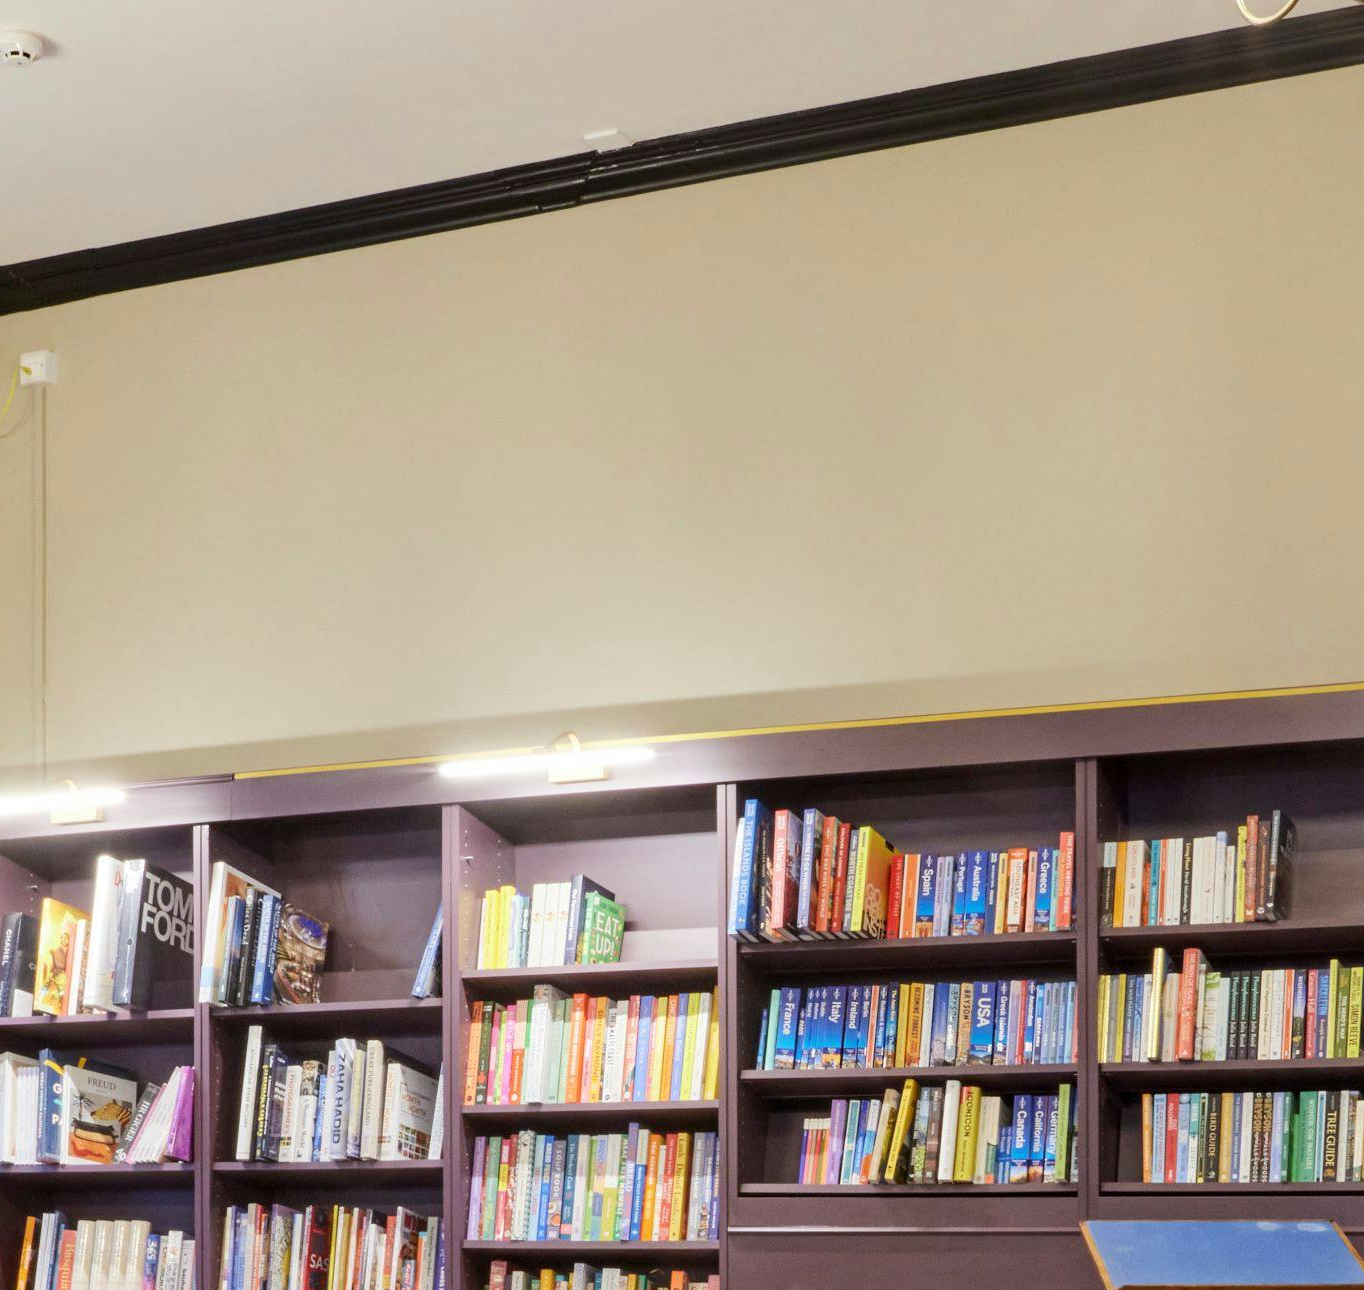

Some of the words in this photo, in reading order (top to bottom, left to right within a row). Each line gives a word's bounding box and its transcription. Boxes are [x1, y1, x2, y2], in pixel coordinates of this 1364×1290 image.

[923, 869, 933, 895] Spain
[972, 866, 982, 901] Australia
[1040, 863, 1050, 893] Greece
[146, 872, 194, 923] TOM
[597, 911, 619, 937] EAT
[2, 929, 12, 966] CHANEL
[596, 934, 614, 956] UP!
[783, 1003, 795, 1035] France
[829, 1002, 842, 1023] Italy
[977, 998, 991, 1027] USA
[88, 1077, 116, 1090] FREUD
[338, 1052, 346, 1097] ZAHA
[333, 1099, 343, 1144] HADID
[1016, 1111, 1027, 1148] Canada
[1326, 1110, 1337, 1134] TREE
[1324, 1136, 1336, 1167] GUIDE
